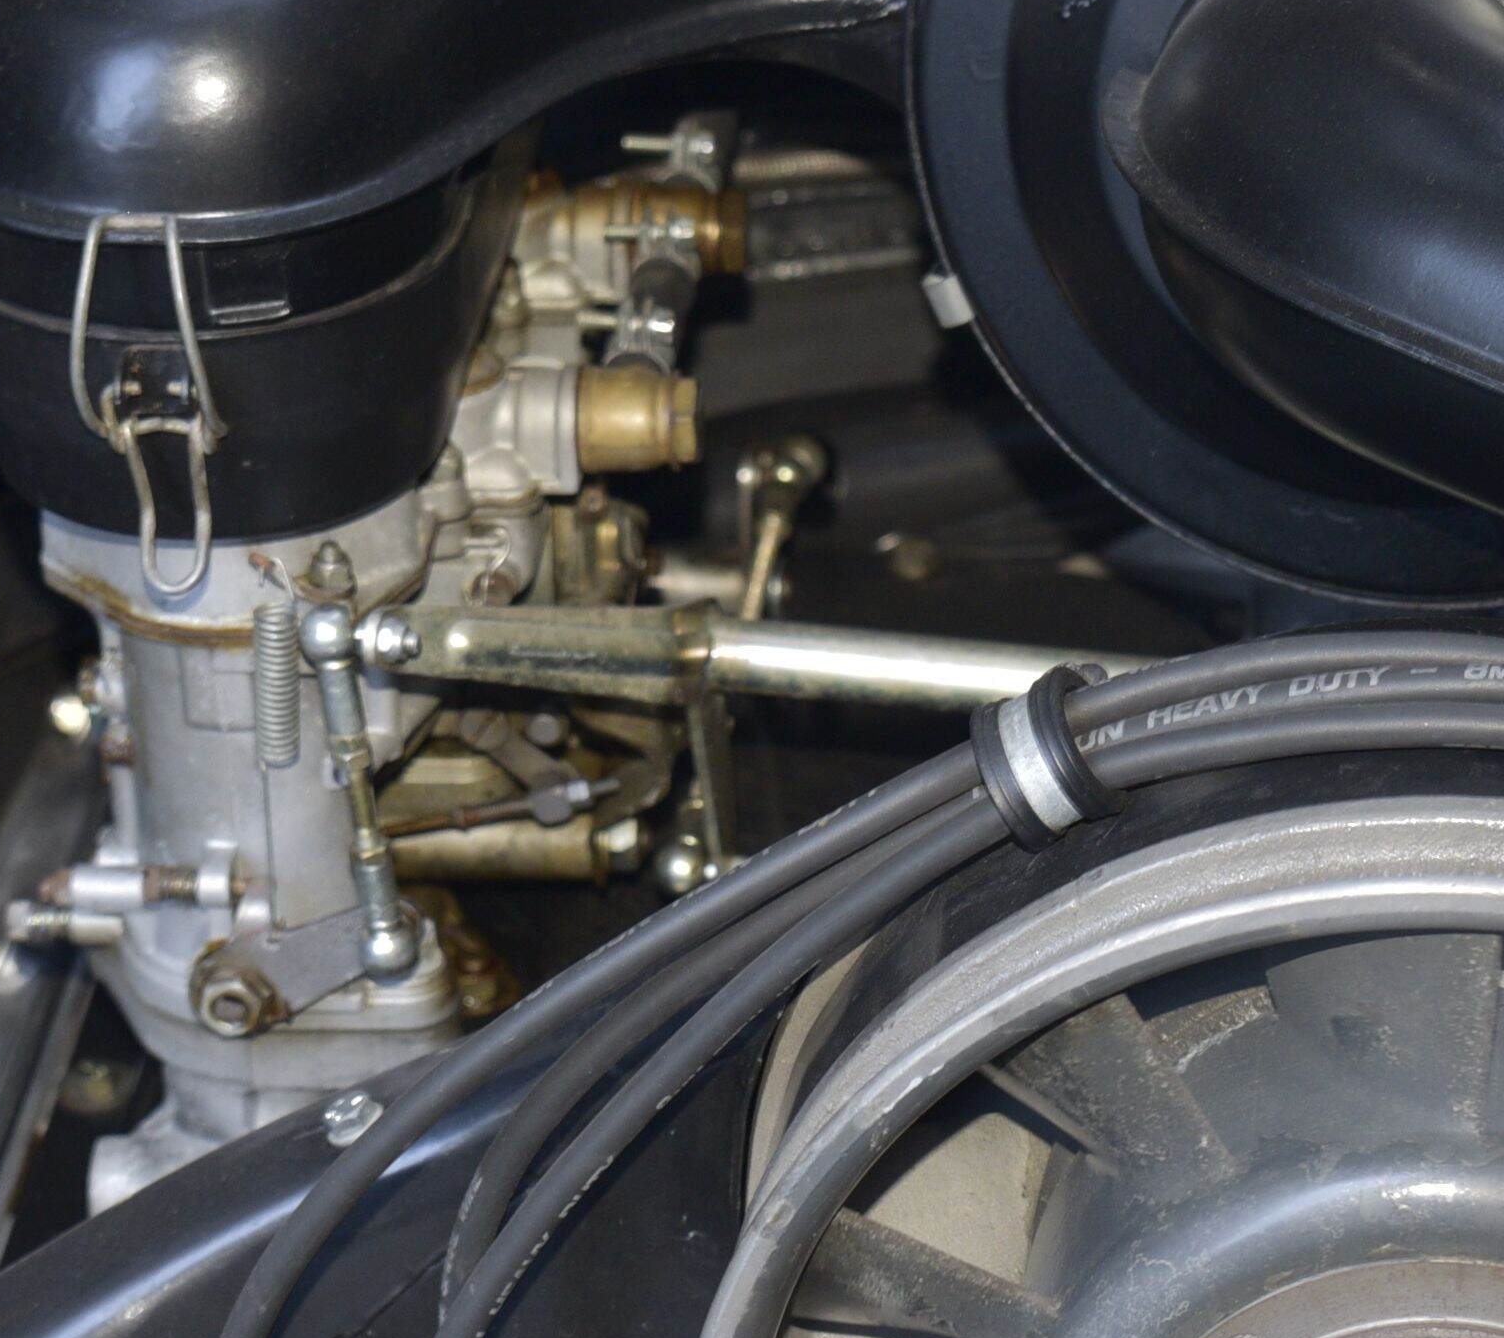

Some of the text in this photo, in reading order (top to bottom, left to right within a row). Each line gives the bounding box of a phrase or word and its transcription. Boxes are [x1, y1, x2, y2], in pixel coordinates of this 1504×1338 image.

[1075, 718, 1126, 751] UN
[1146, 683, 1271, 729] HEAVY
[1288, 665, 1392, 698] DUTY
